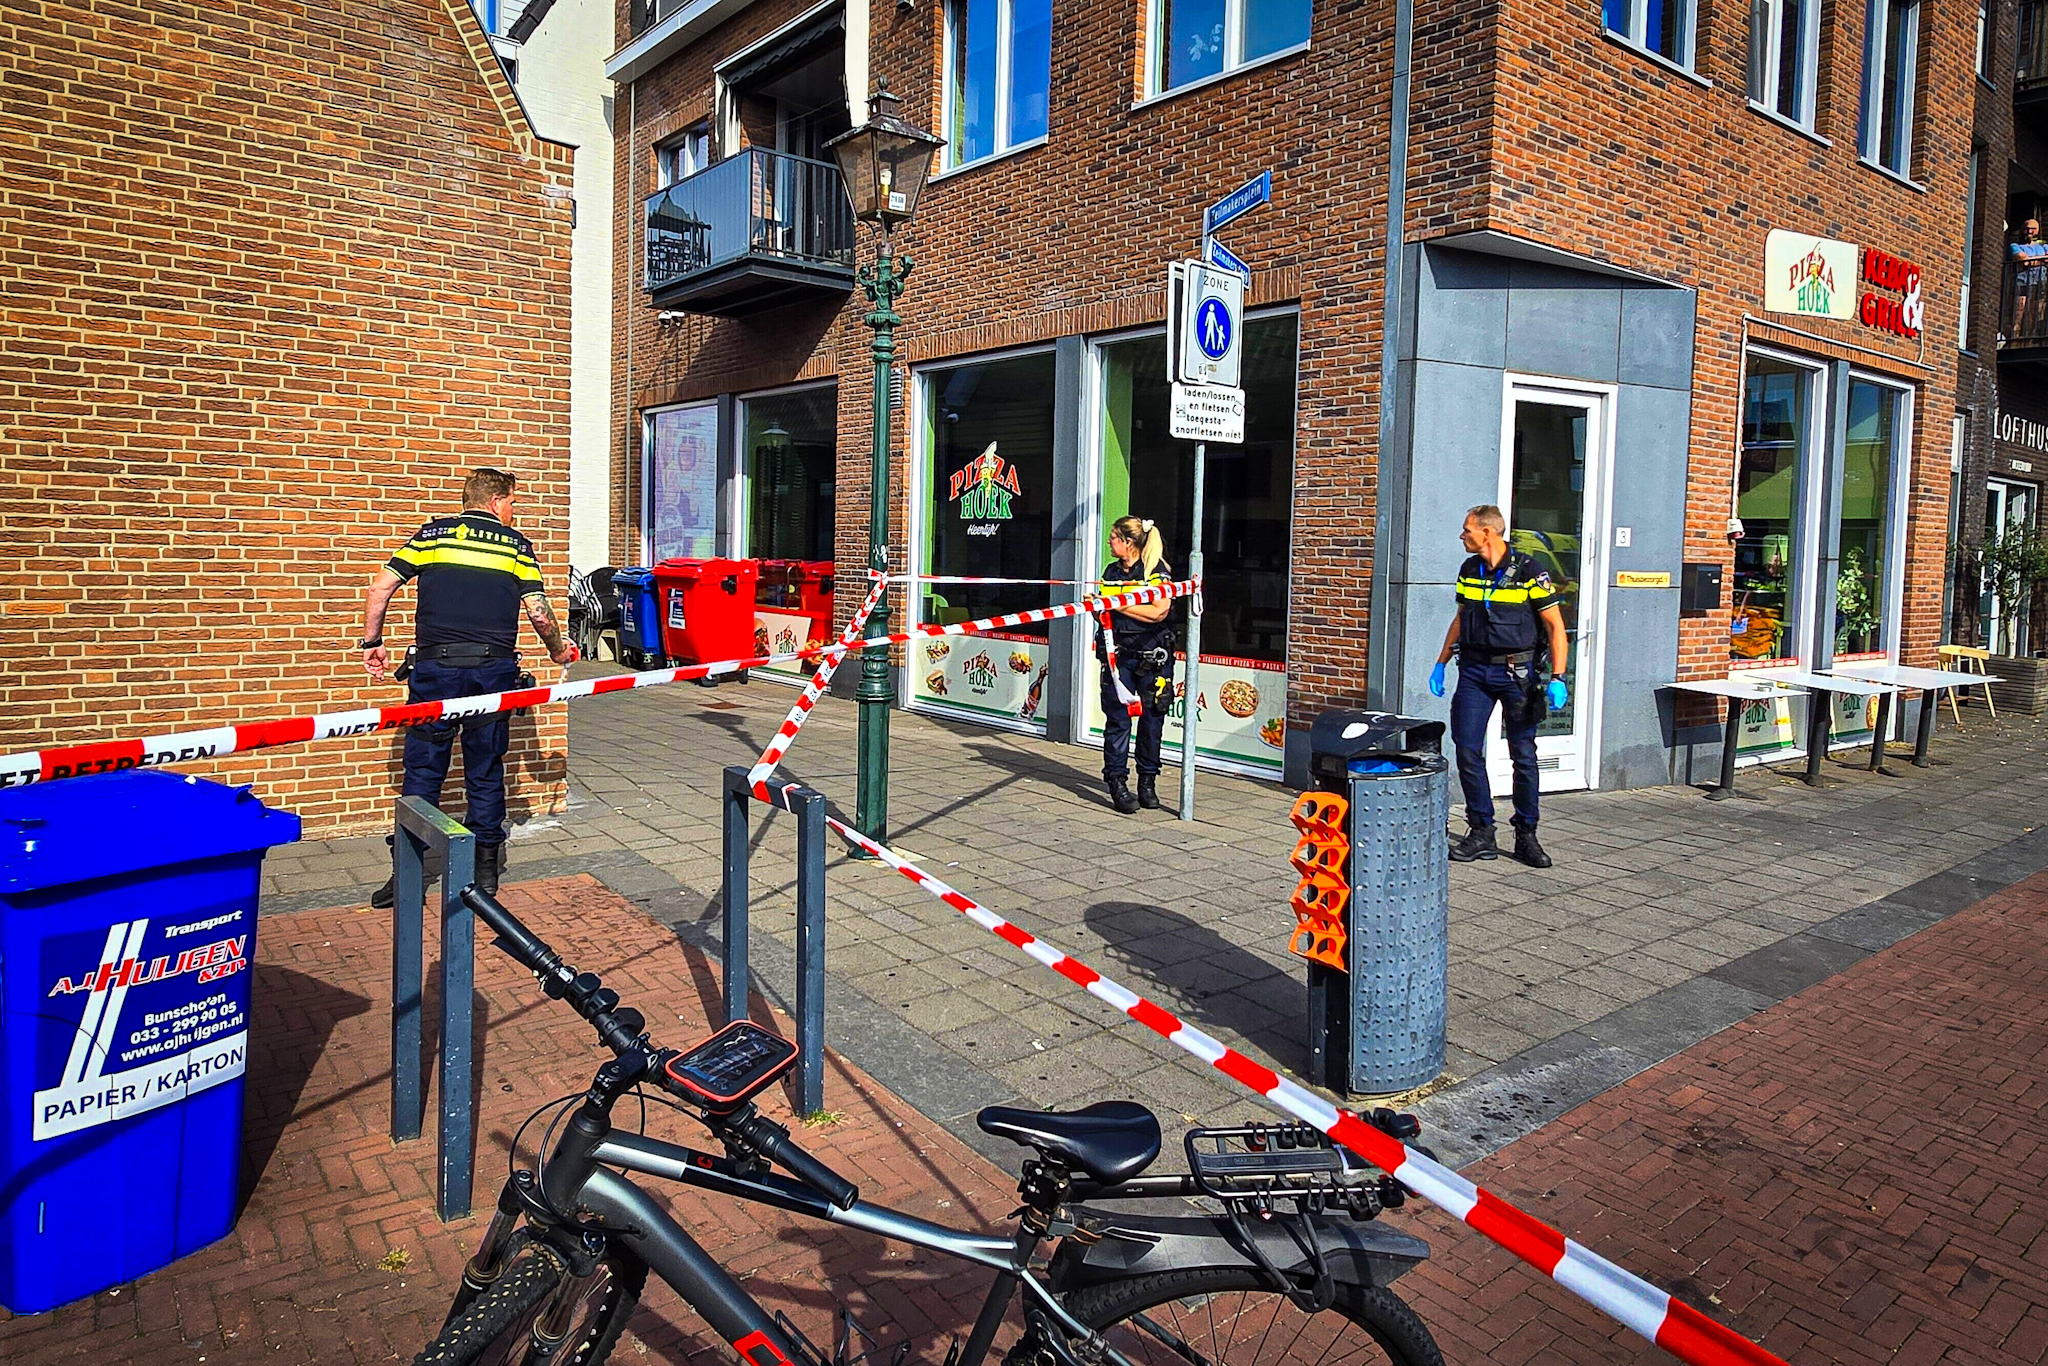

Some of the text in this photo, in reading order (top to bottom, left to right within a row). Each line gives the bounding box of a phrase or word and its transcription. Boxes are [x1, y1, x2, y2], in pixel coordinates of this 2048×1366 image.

[1210, 183, 1262, 222] Zeilmakersplein
[1203, 275, 1229, 291] ZONE
[1789, 251, 1836, 294] PIZZA
[1797, 280, 1831, 314] HOEK
[1184, 387, 1236, 402] laden/lossen
[1189, 402, 1230, 414] en fietsen
[1186, 414, 1226, 426] toegesta
[1175, 426, 1241, 439] snorfietsen niet
[949, 452, 1022, 502] PIZZA
[960, 484, 1013, 519] HOEK
[1619, 530, 1627, 544] 3
[962, 654, 998, 678] PIZZA
[1262, 662, 1285, 672] PASTA'S
[968, 669, 994, 688] HOEK
[1167, 699, 1202, 722] HOK
[0, 768, 41, 788] ET
[164, 910, 243, 938] Transport
[130, 1026, 160, 1045] 033
[172, 1014, 199, 1034] 299
[200, 1008, 217, 1024] 90
[219, 1001, 237, 1018] 05
[43, 1045, 244, 1124] PAPIER / KARTON
